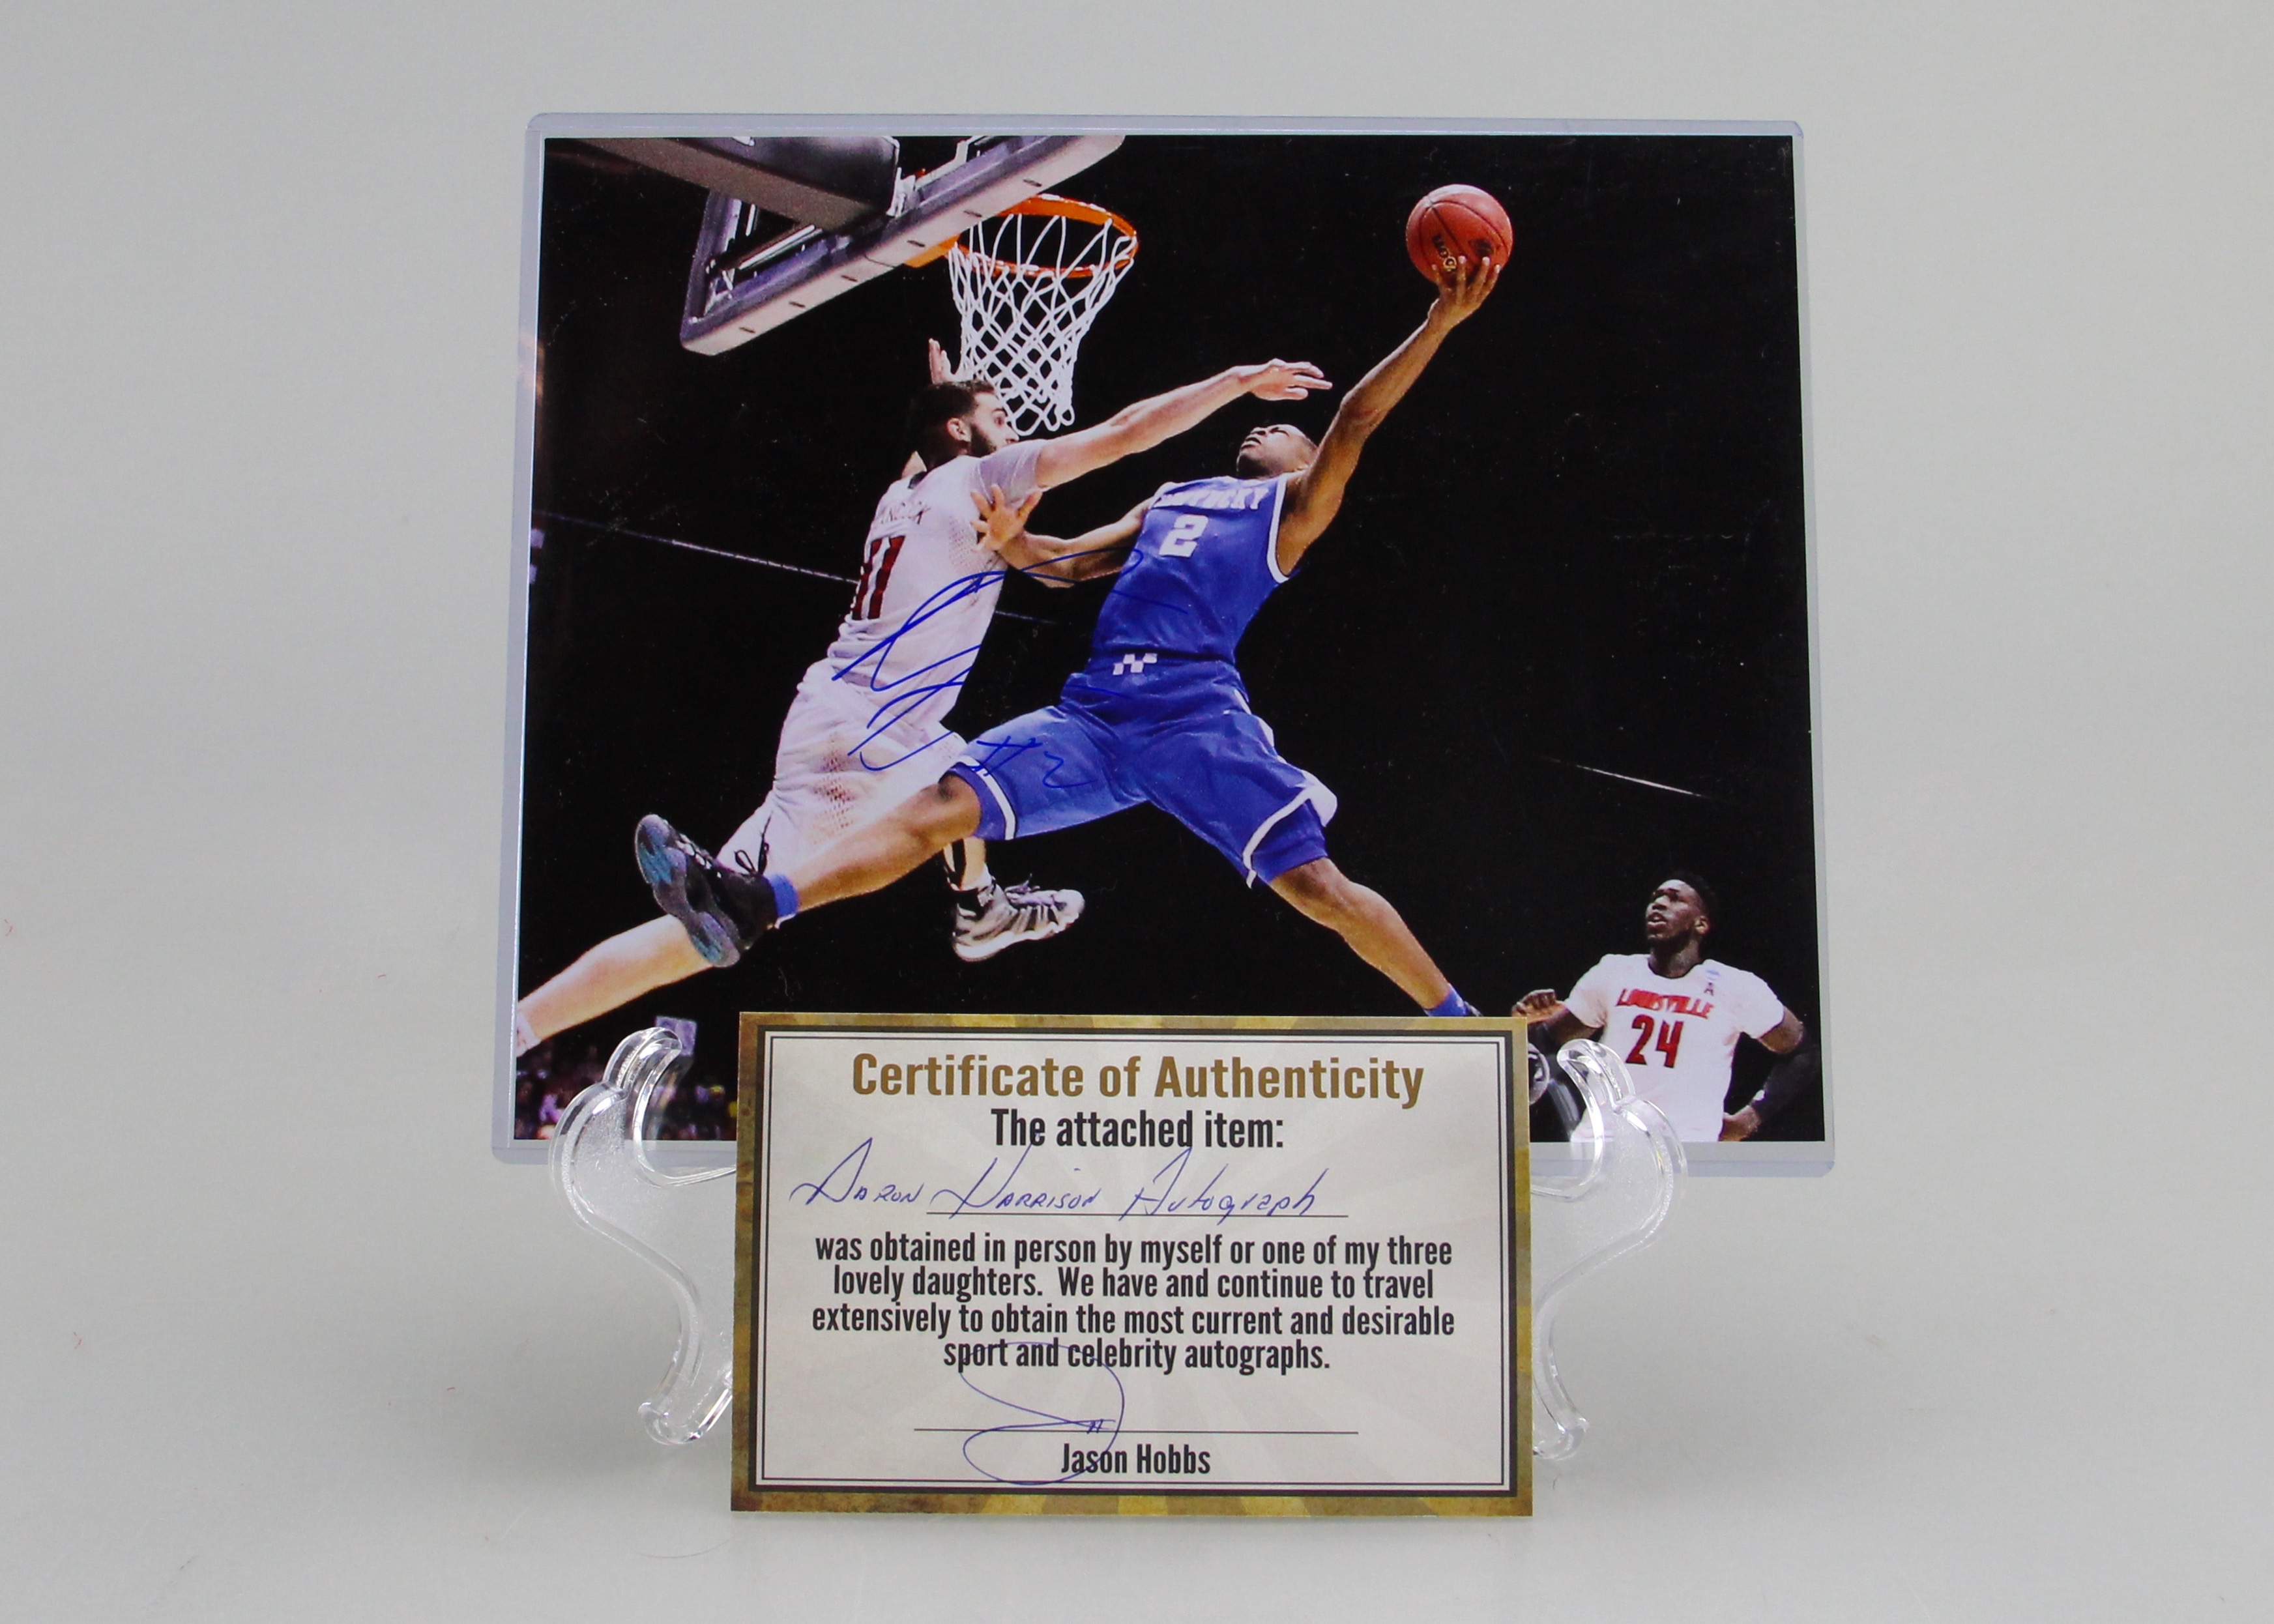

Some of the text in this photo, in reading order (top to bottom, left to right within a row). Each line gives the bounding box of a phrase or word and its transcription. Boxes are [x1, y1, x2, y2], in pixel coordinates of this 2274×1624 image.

[1158, 514, 1209, 558] 2
[1615, 988, 1715, 1019] LOUISVILLE
[1625, 1014, 1684, 1069] 24
[852, 1052, 1425, 1109] Certificate of Authenticity
[991, 1109, 1284, 1149] The attached item:
[815, 1231, 1452, 1272] was obtained in person by myself or one of my three
[834, 1264, 1433, 1303] lovely daughters. We have and continue to travel
[812, 1302, 1454, 1339] extensively to obtain the most current and desirable
[944, 1337, 1330, 1376] sport and celebrity autographs.
[1061, 1443, 1210, 1474] Jason Hobbs
